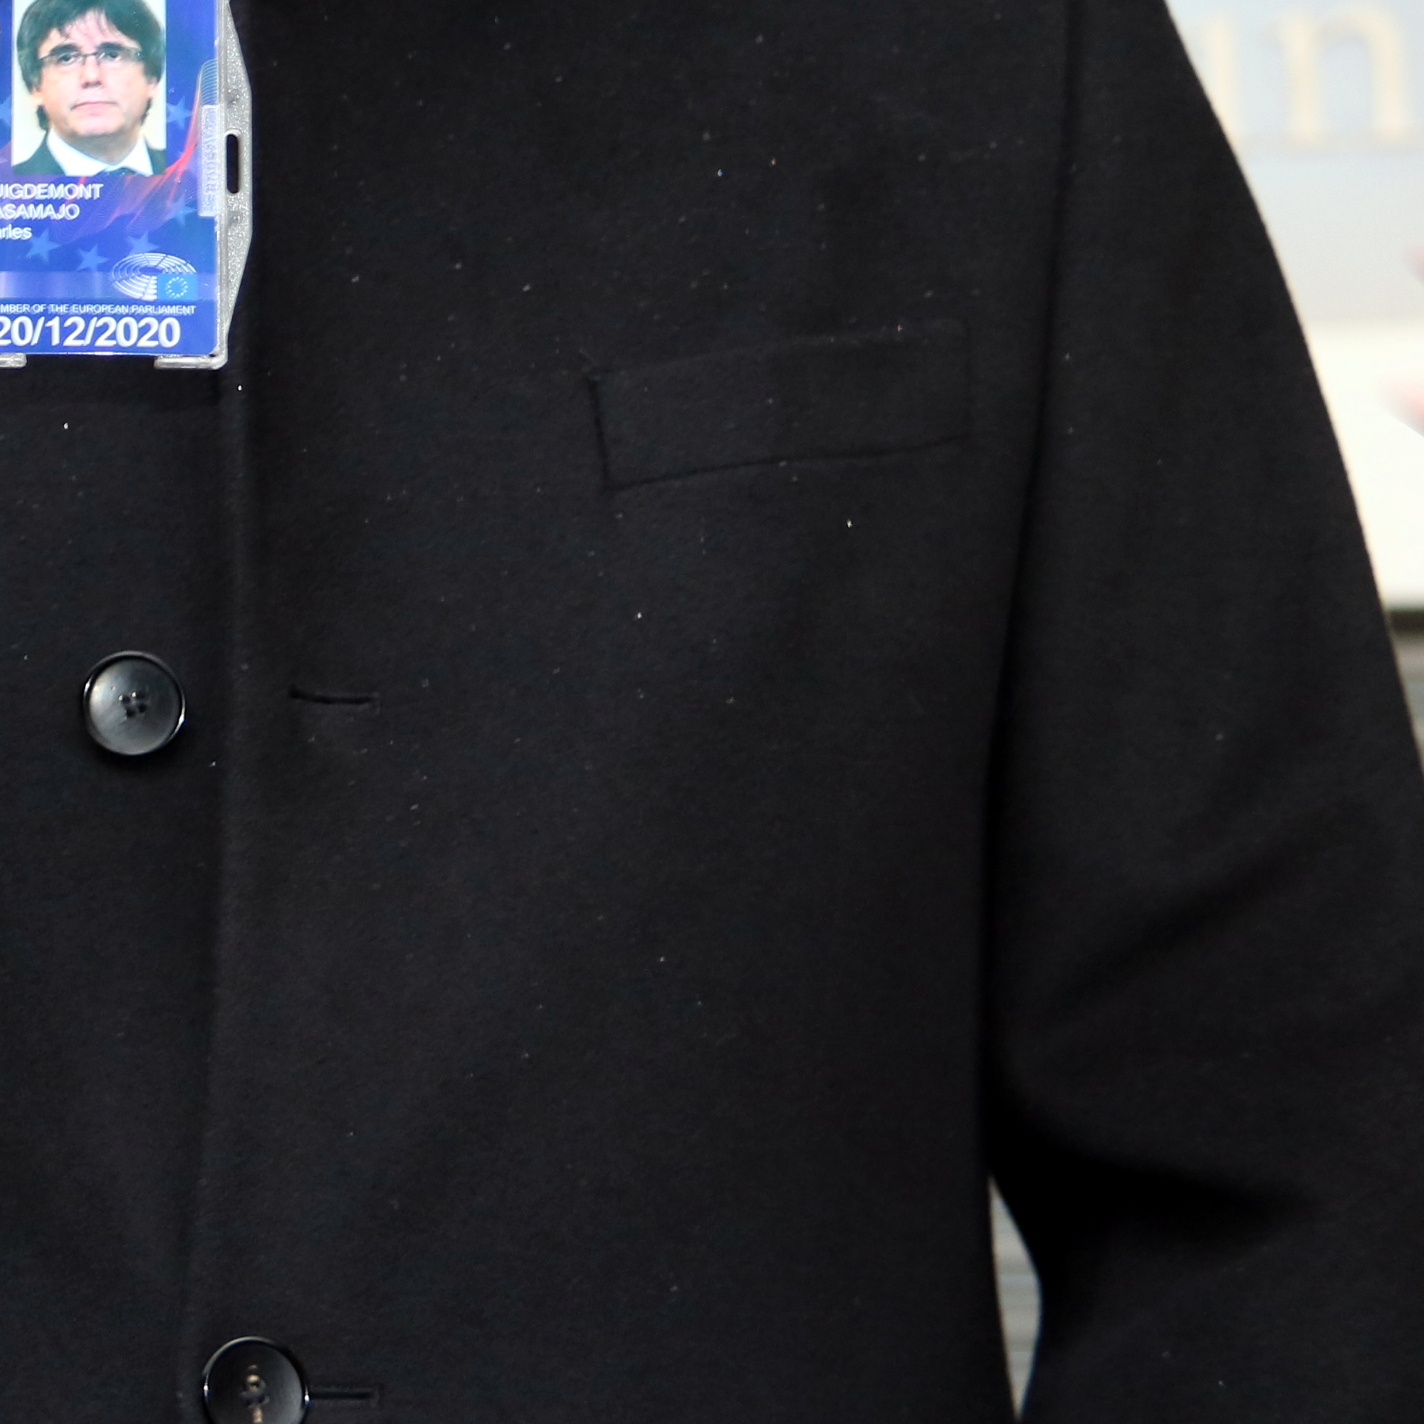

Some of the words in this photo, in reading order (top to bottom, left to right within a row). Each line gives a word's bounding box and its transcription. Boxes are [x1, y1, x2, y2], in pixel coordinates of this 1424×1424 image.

[30, 303, 47, 314] OF
[48, 303, 70, 315] THE
[70, 304, 129, 316] EUROPEAN
[130, 304, 197, 317] PARLIAMENT
